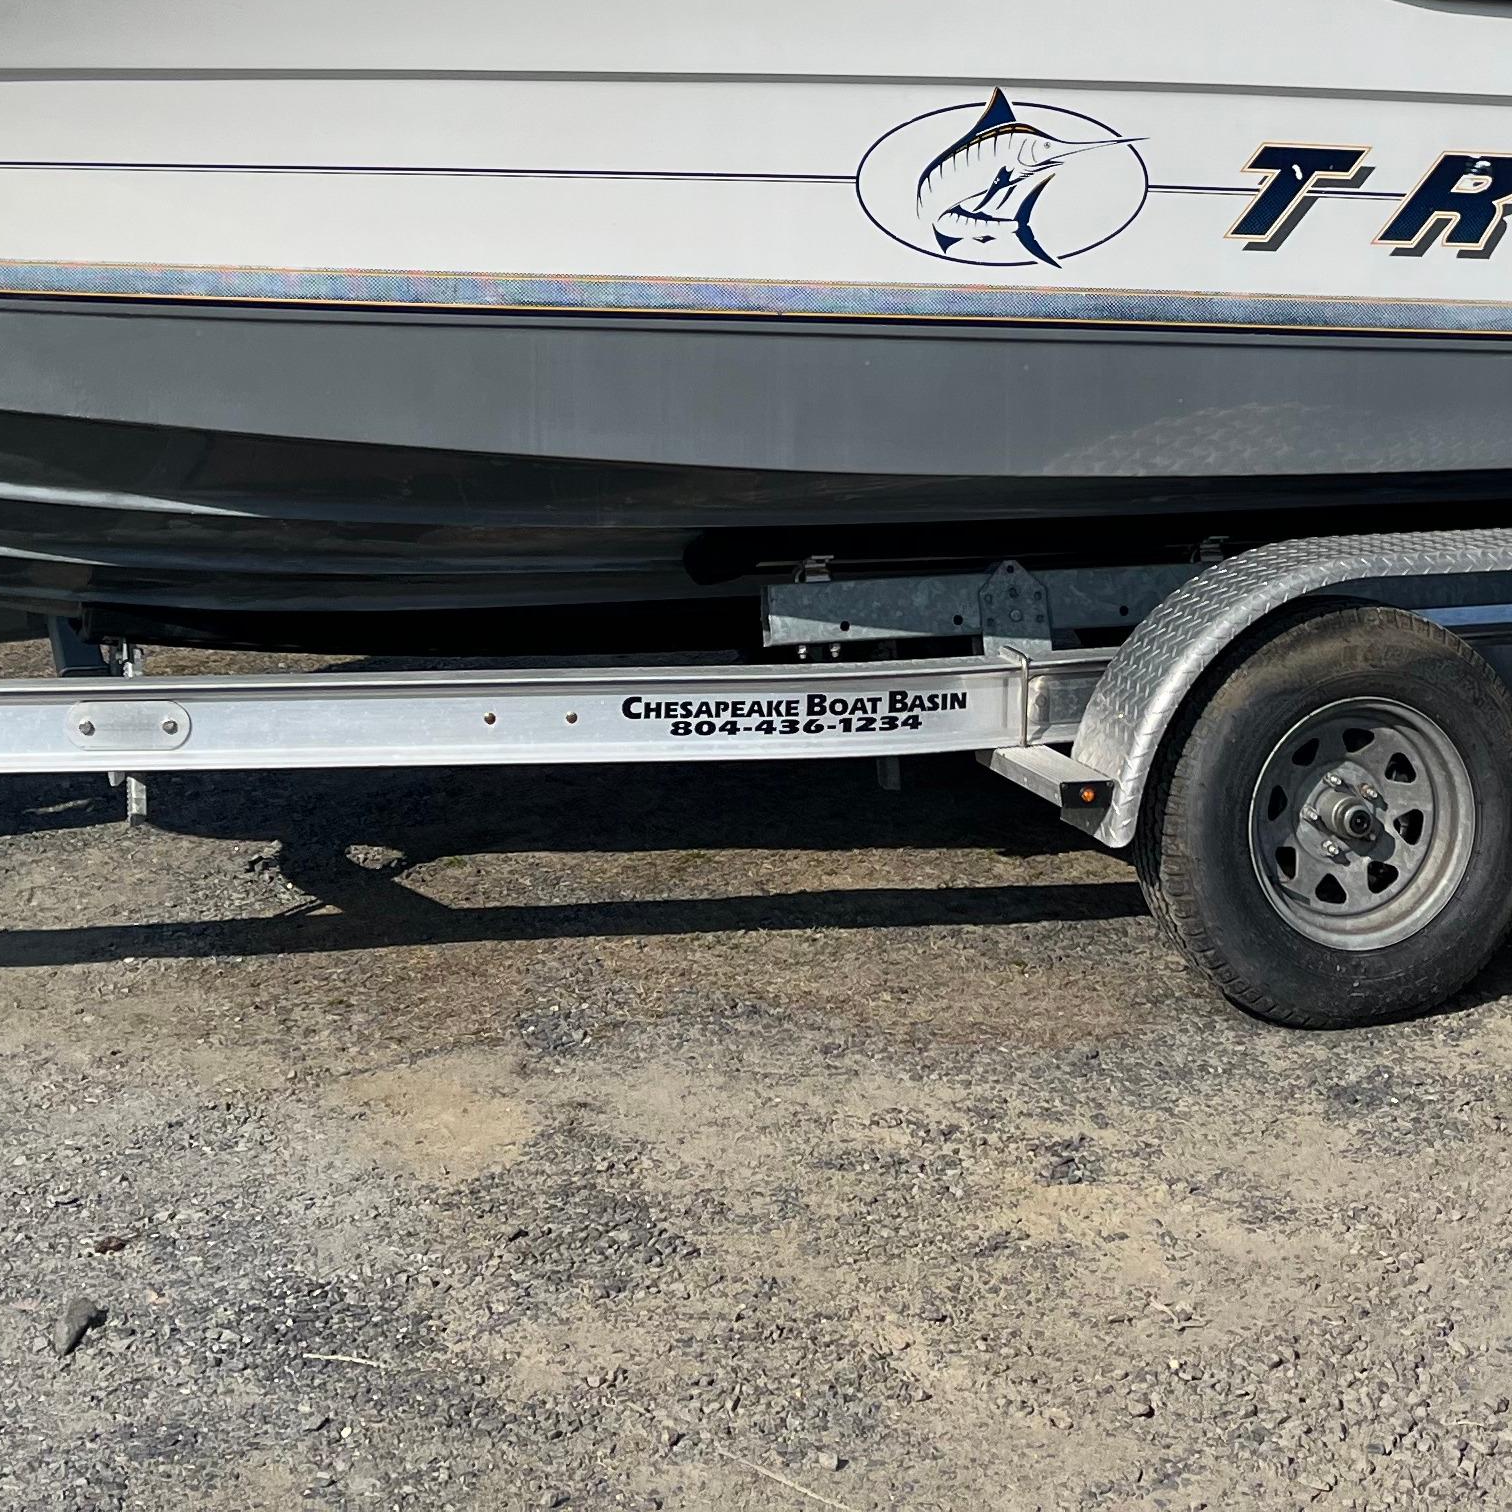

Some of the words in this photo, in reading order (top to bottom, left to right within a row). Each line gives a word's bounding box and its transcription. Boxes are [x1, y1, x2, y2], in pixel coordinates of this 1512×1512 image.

[806, 693, 882, 716] BOAT
[888, 690, 968, 714] BASIN
[669, 714, 923, 737] 804-436-1234
